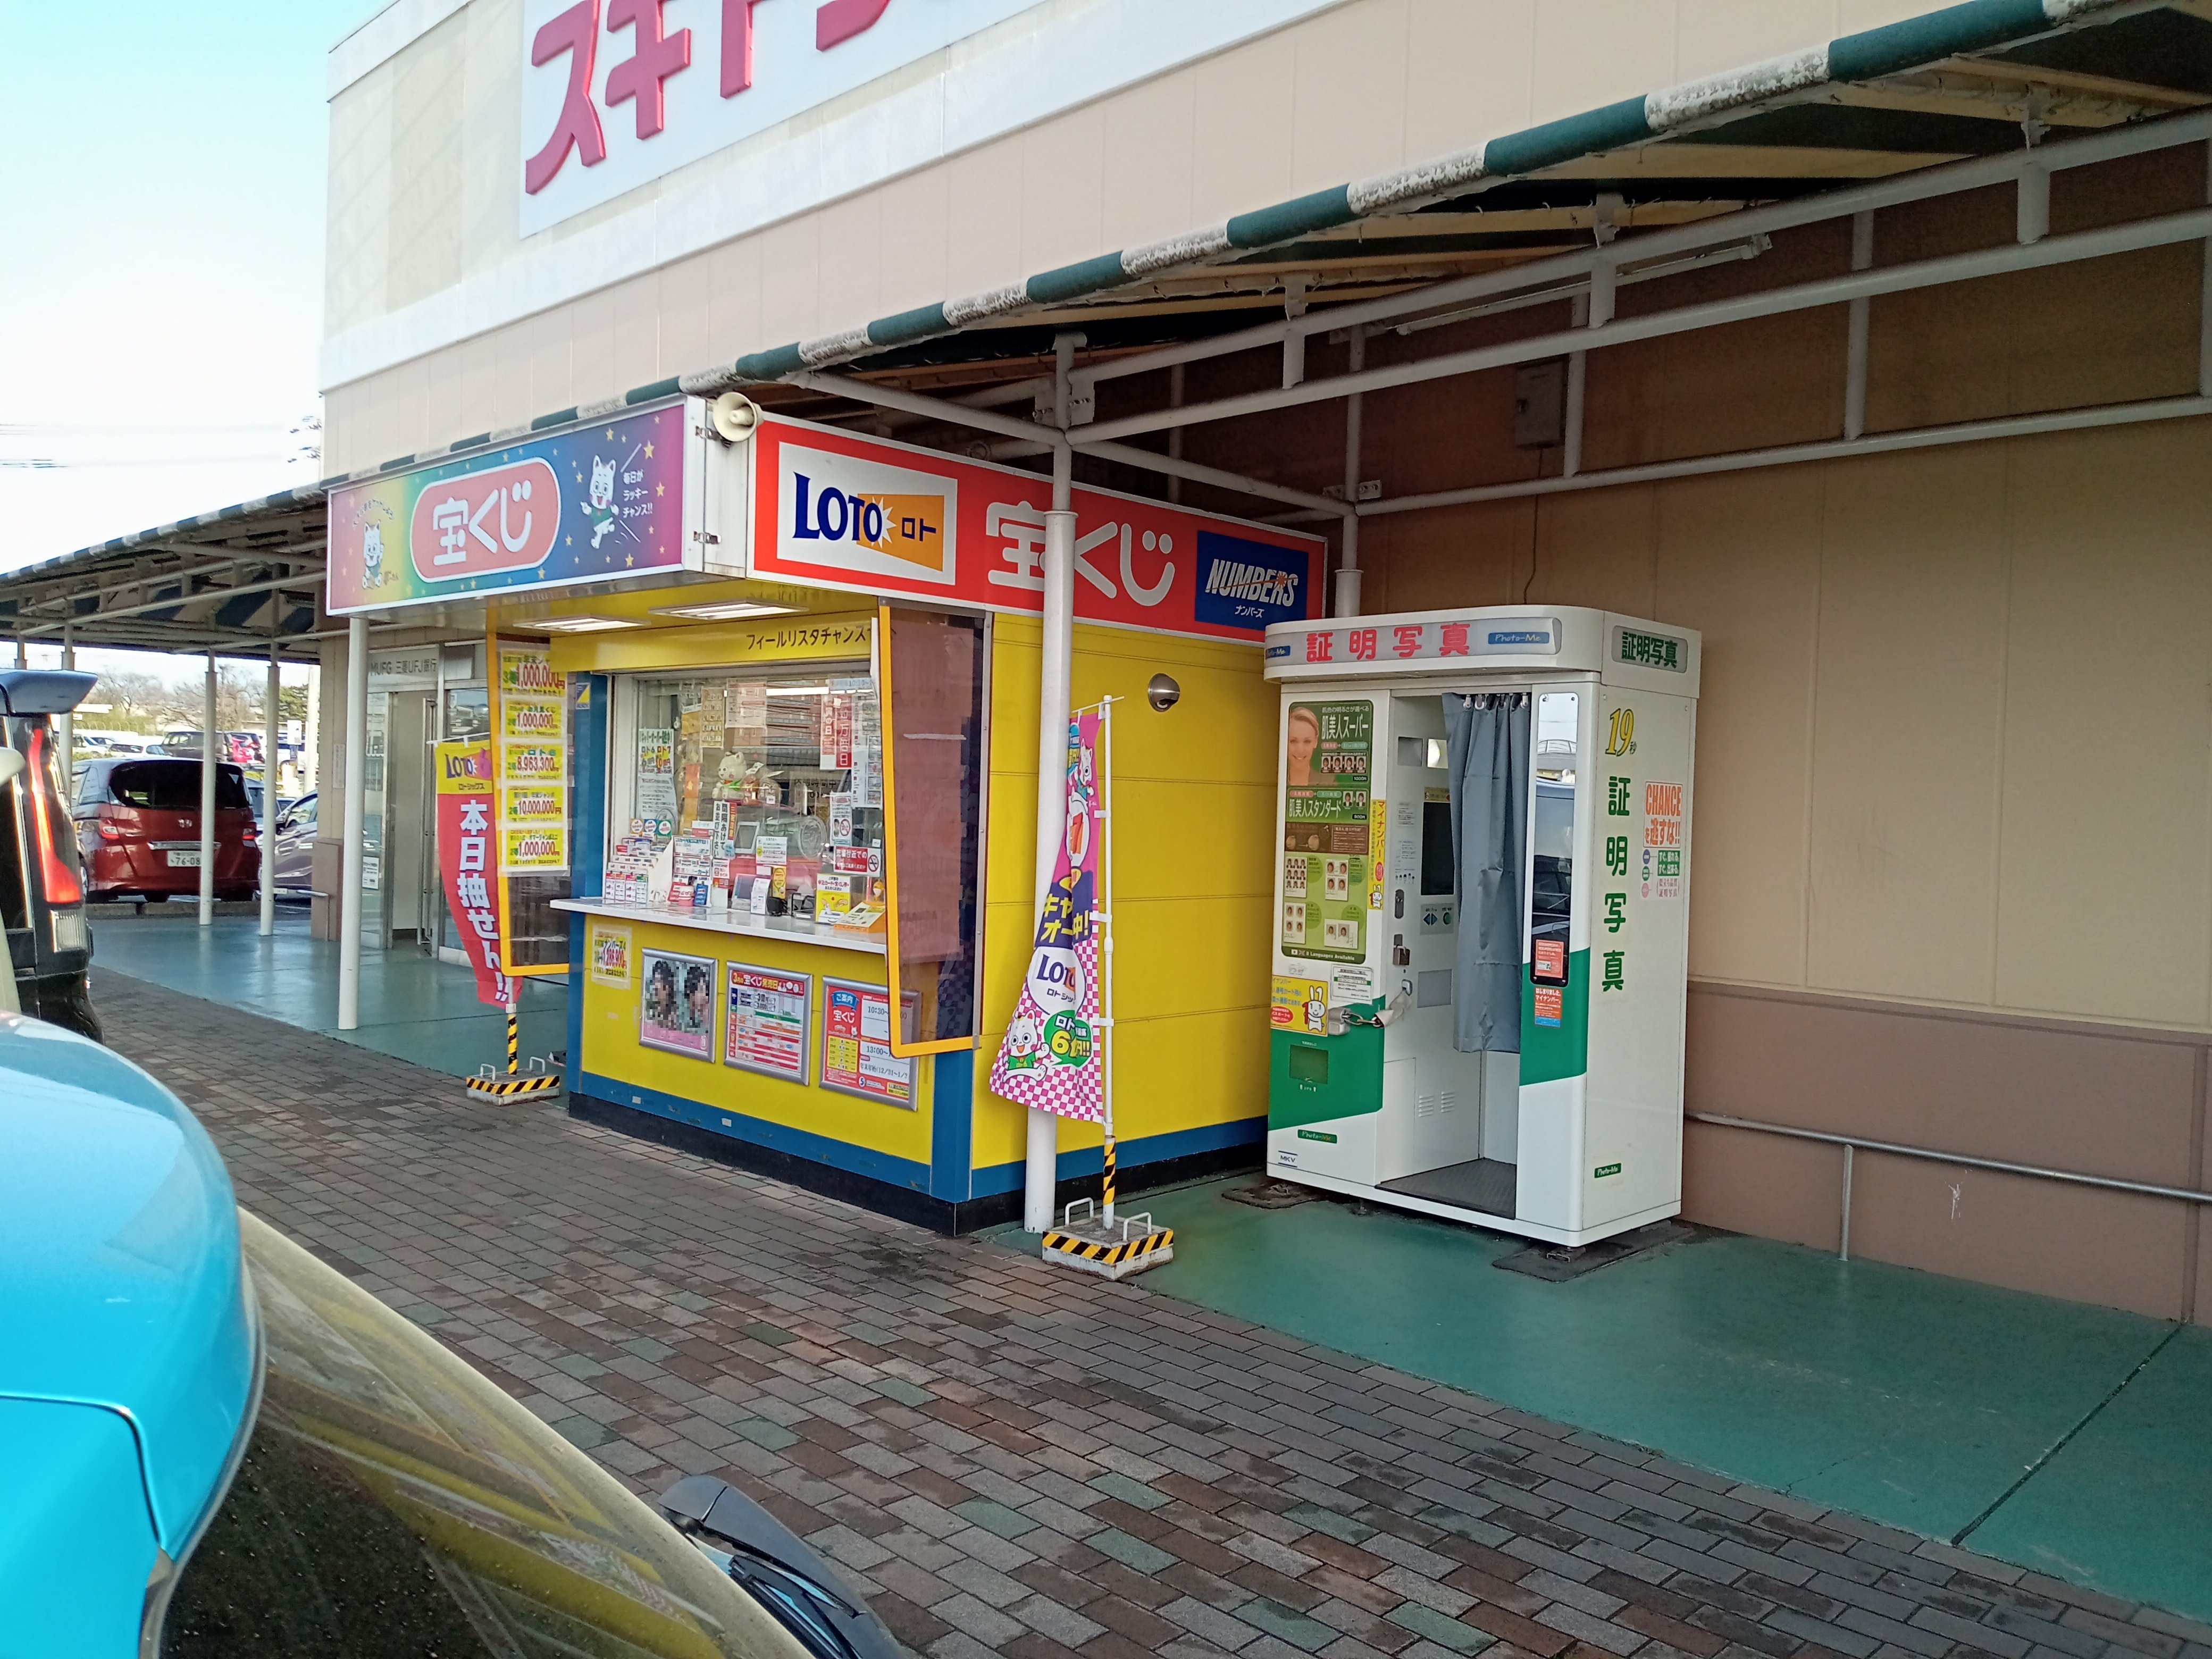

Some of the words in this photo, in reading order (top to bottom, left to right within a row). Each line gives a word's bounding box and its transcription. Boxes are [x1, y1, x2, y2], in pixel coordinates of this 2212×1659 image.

[623, 487, 648, 501] ラッキー
[623, 502, 653, 518] チャンス!!
[792, 472, 883, 543] LOTO
[902, 518, 937, 542] ロト
[432, 480, 532, 566] 宝くじ
[985, 500, 1175, 607] 宝くじ
[1204, 558, 1298, 607] NUMBERS
[1234, 605, 1265, 618] ナンバーズ
[1306, 623, 1471, 662] 証明写真
[1495, 634, 1541, 643] Photo-Me
[1622, 631, 1678, 668] 証明写真
[371, 661, 392, 676] MUFG
[396, 658, 437, 674] 三菱UFJ銀行
[1321, 713, 1369, 740] 肌美人スーパー
[445, 753, 473, 778] LOTO
[1288, 798, 1342, 818] 肌美人スタンダード
[1645, 783, 1681, 817] CHANCE
[1376, 800, 1385, 858] マイナンバー
[175, 857, 201, 865] 76-08
[1602, 776, 1631, 993] 証明写真
[456, 799, 508, 1002] 本日抽せん!!
[836, 993, 854, 1004] ご案内
[833, 1010, 855, 1024] 宝くじ
[1280, 1154, 1296, 1163] MKV
